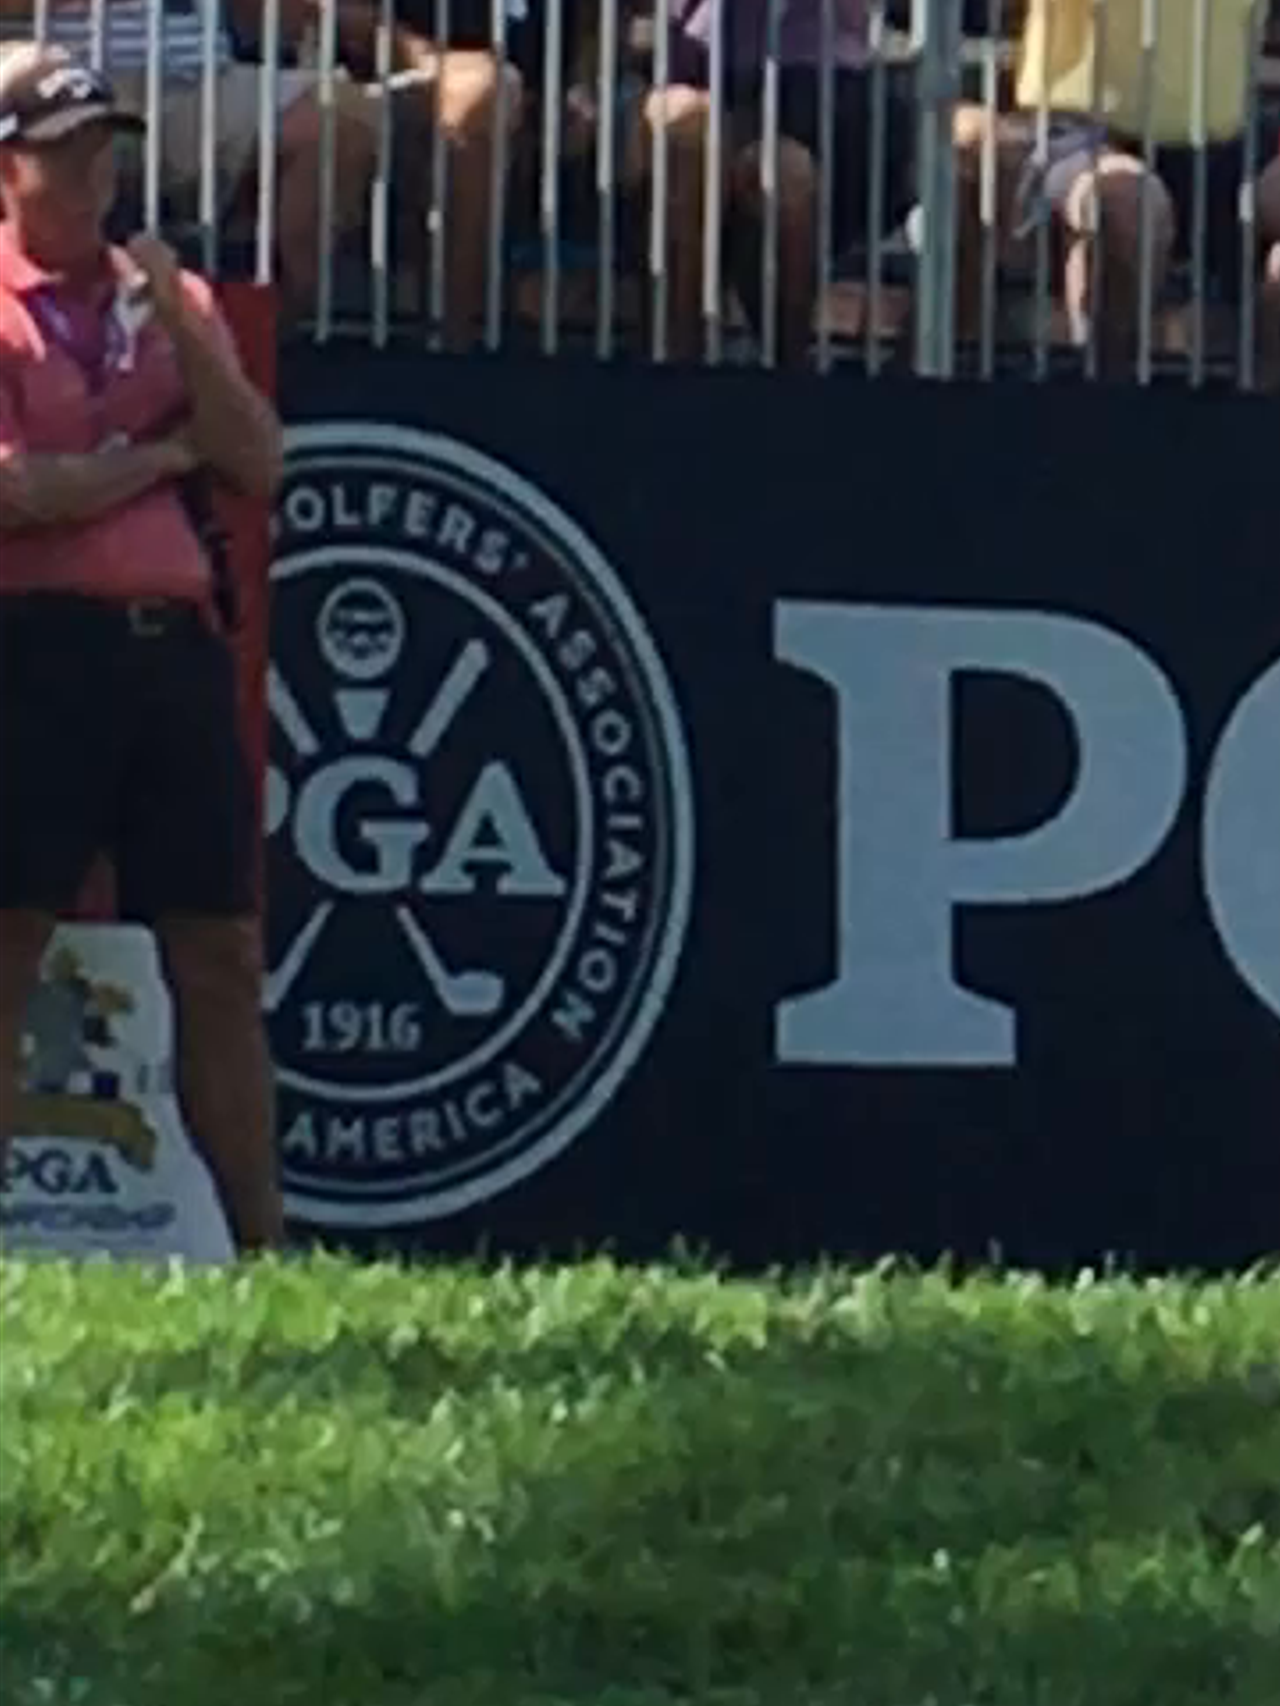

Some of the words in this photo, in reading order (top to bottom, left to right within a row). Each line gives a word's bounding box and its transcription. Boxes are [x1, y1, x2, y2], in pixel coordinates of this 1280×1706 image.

[269, 485, 531, 574] OLFERS'
[528, 593, 644, 1042] ASSOCIATION
[303, 1000, 422, 1052] 1916
[282, 1061, 543, 1161] AMERICA
